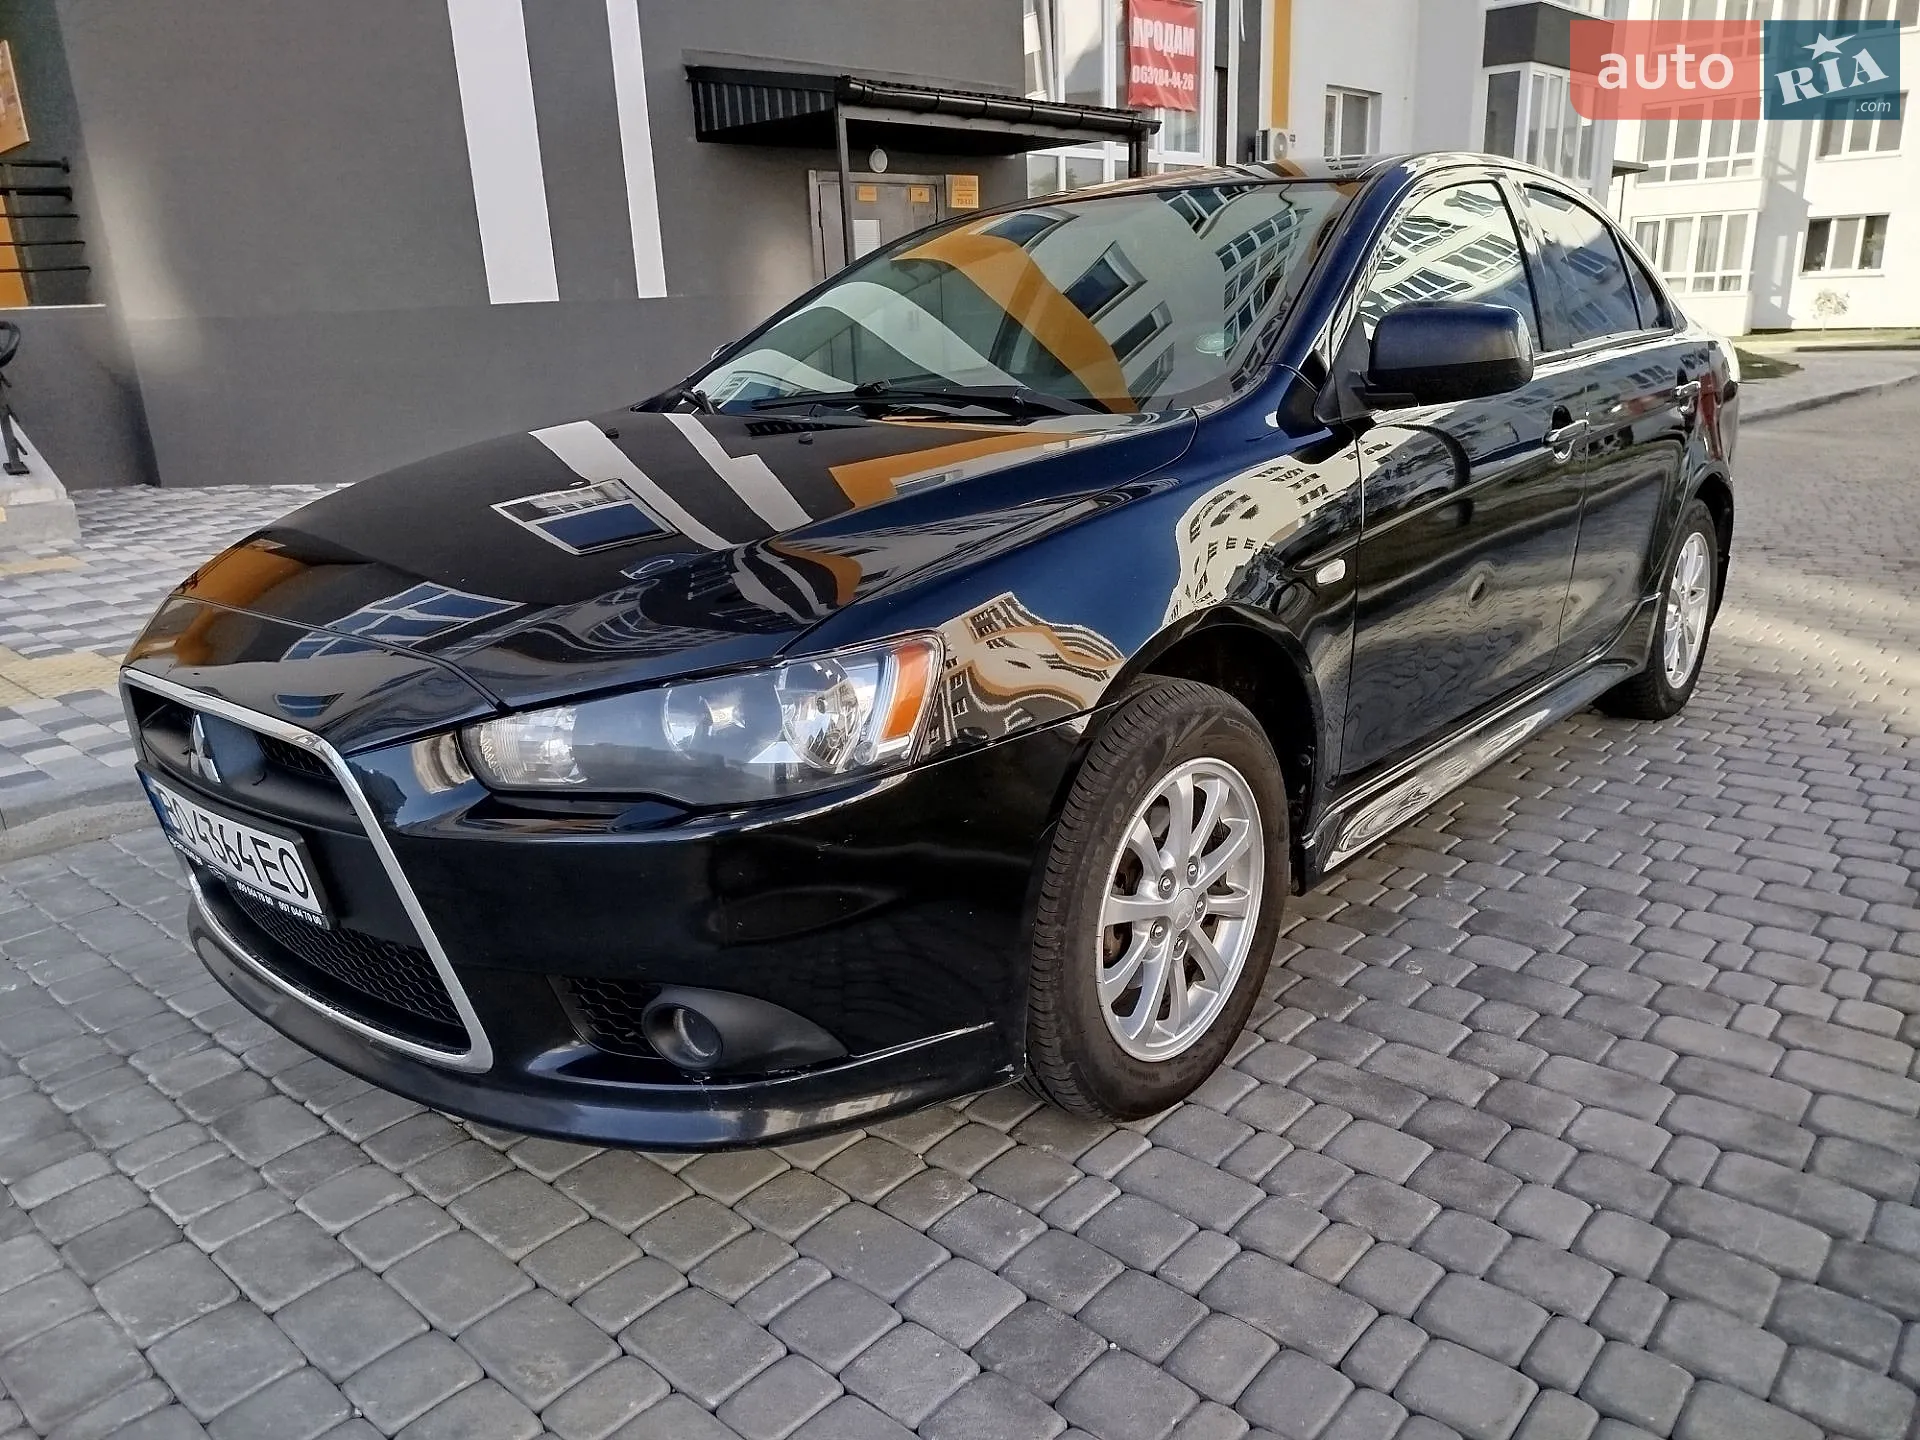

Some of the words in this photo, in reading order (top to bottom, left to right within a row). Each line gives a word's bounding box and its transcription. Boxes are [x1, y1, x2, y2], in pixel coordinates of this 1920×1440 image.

[1132, 16, 1196, 58] ПРОДАМ
[192, 809, 262, 883] 4364
[249, 835, 309, 900] EO
